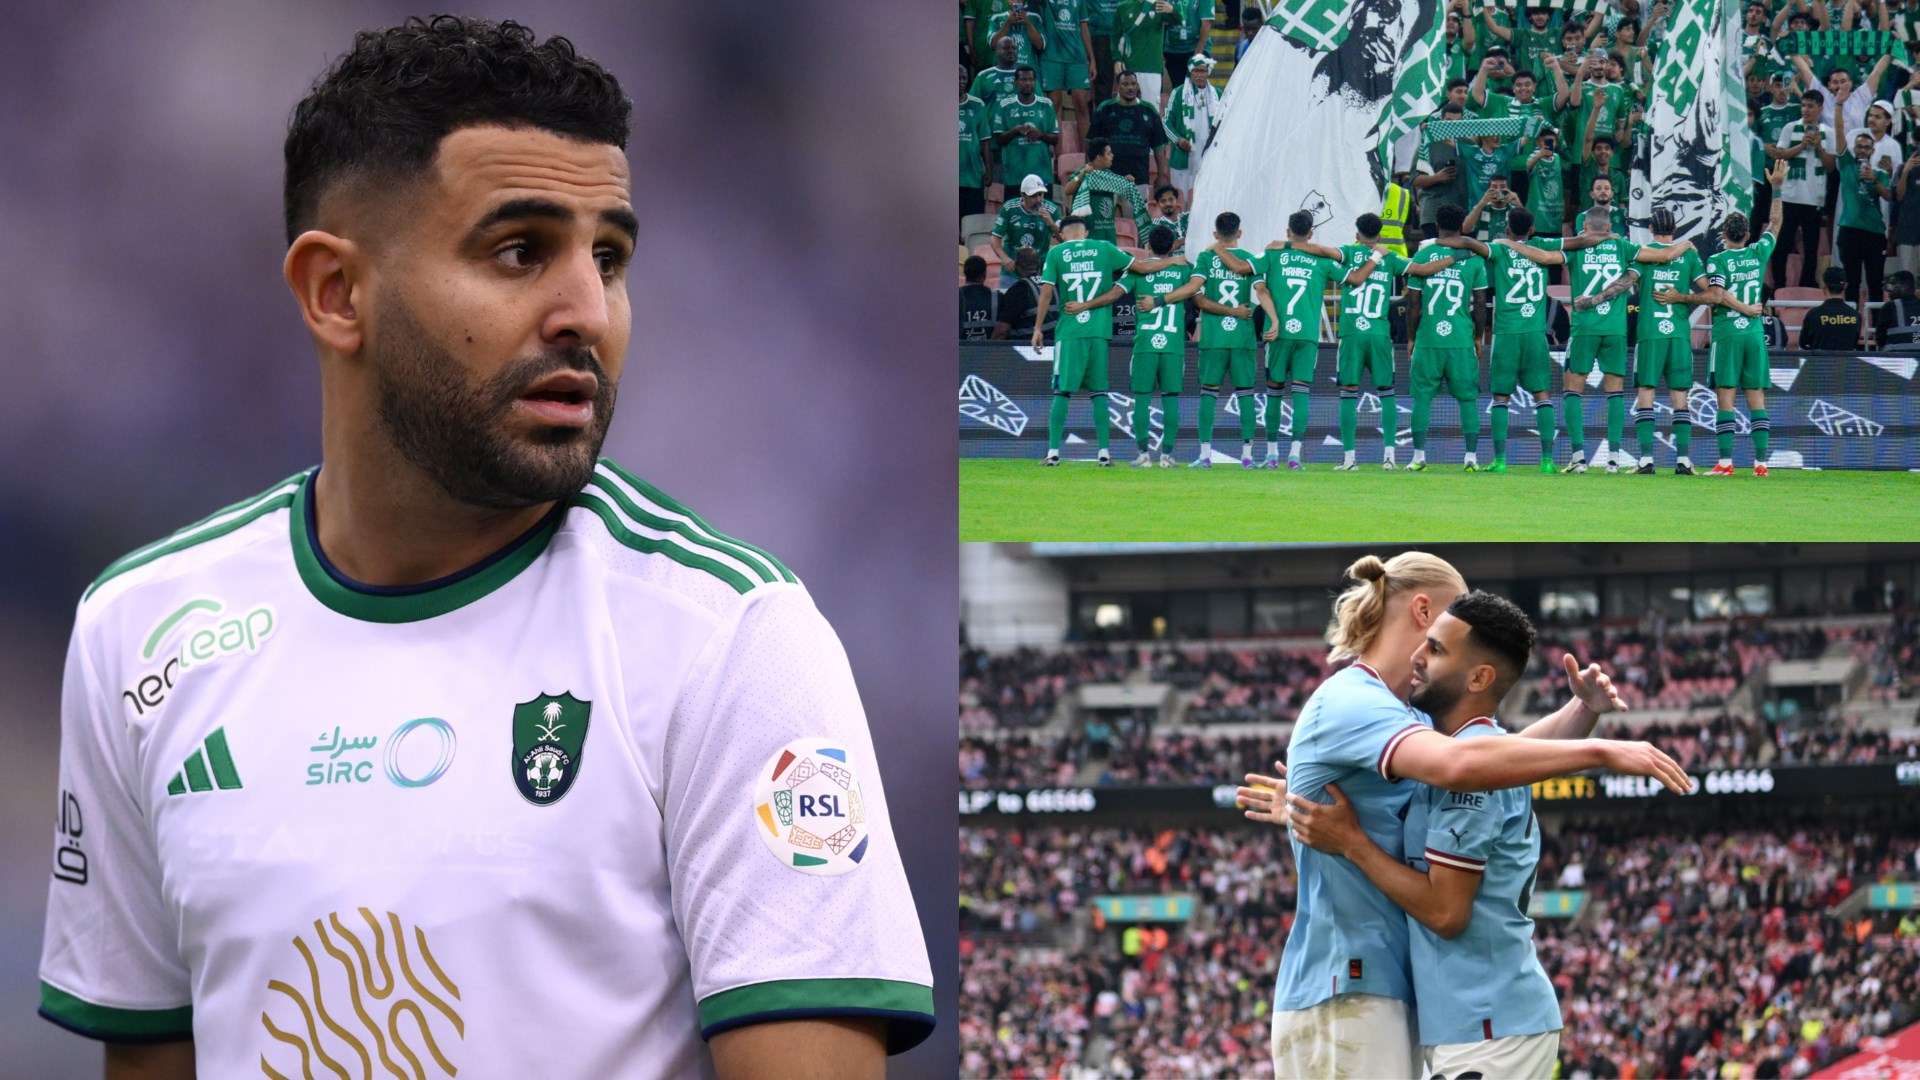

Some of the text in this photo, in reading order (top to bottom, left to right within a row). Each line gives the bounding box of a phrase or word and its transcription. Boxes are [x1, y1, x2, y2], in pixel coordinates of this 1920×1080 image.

[1072, 248, 1098, 258] urpay
[1218, 280, 1240, 308] 8
[1286, 278, 1307, 315] 7
[1426, 278, 1464, 316] 79
[1505, 267, 1544, 303] 20
[966, 310, 988, 322] 142
[1820, 315, 1856, 325] Police
[305, 760, 374, 786] SIRC
[535, 790, 552, 798] 1937
[799, 794, 846, 818] RSL
[1449, 791, 1484, 808] TIRE
